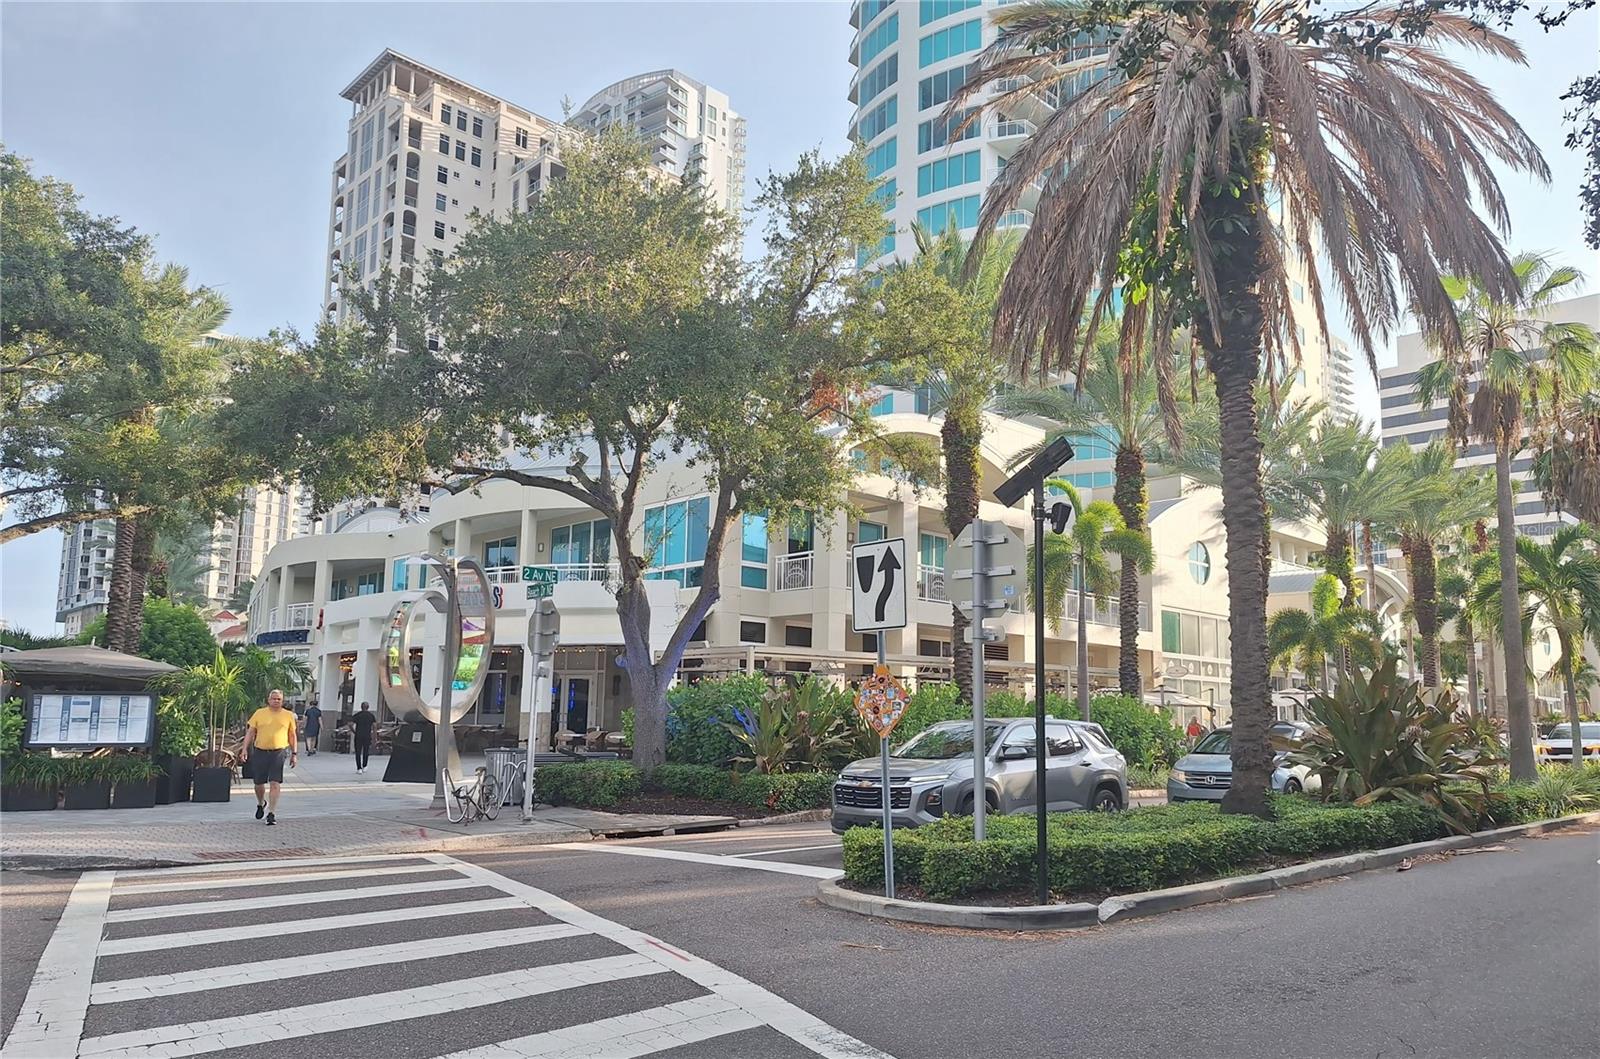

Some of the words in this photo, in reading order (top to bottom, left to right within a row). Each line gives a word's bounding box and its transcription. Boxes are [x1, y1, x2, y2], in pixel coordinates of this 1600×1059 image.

[524, 568, 530, 579] 2
[532, 569, 543, 580] Av
[545, 570, 556, 582] NE
